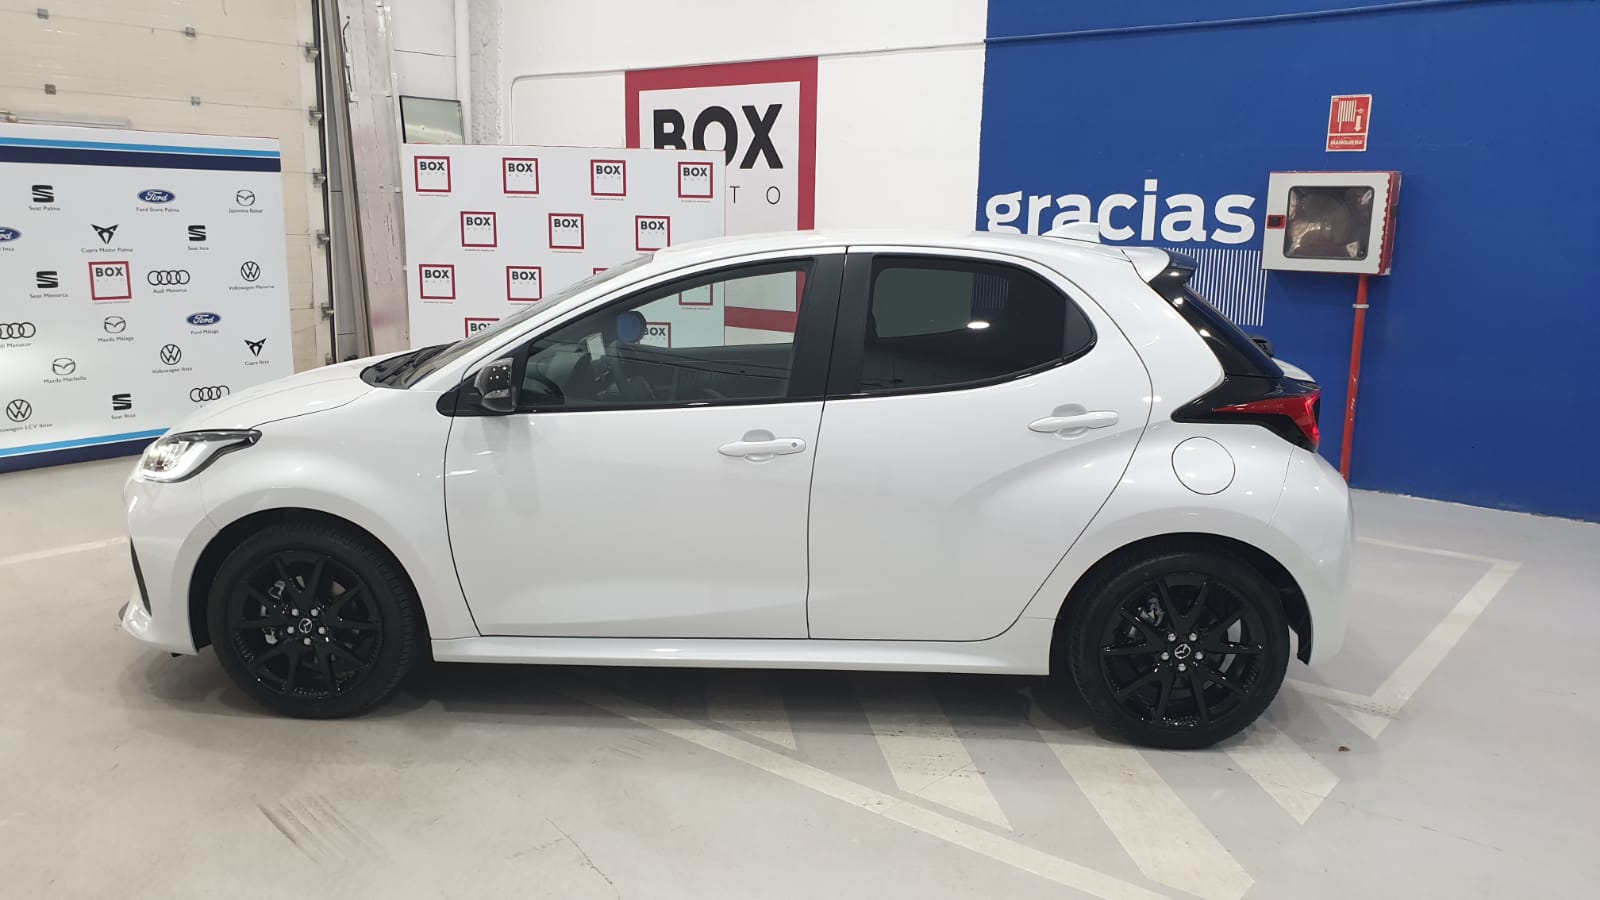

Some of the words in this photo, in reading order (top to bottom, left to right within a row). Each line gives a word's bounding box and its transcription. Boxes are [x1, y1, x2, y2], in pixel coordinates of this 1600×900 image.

[653, 103, 784, 170] BOX
[420, 161, 445, 171] BOX
[508, 163, 533, 173] BOX
[596, 164, 621, 175] BOX
[682, 167, 708, 177] BOX
[145, 191, 168, 202] Ford
[729, 185, 781, 205] TO
[985, 178, 1256, 244] gracias
[466, 216, 491, 226] BOX
[553, 218, 579, 229] BOX
[640, 220, 665, 231] BOX
[95, 266, 124, 277] BOX
[424, 269, 450, 279] BOX
[512, 271, 537, 281] BOX
[192, 314, 215, 325] Ford
[470, 322, 491, 332] BO
